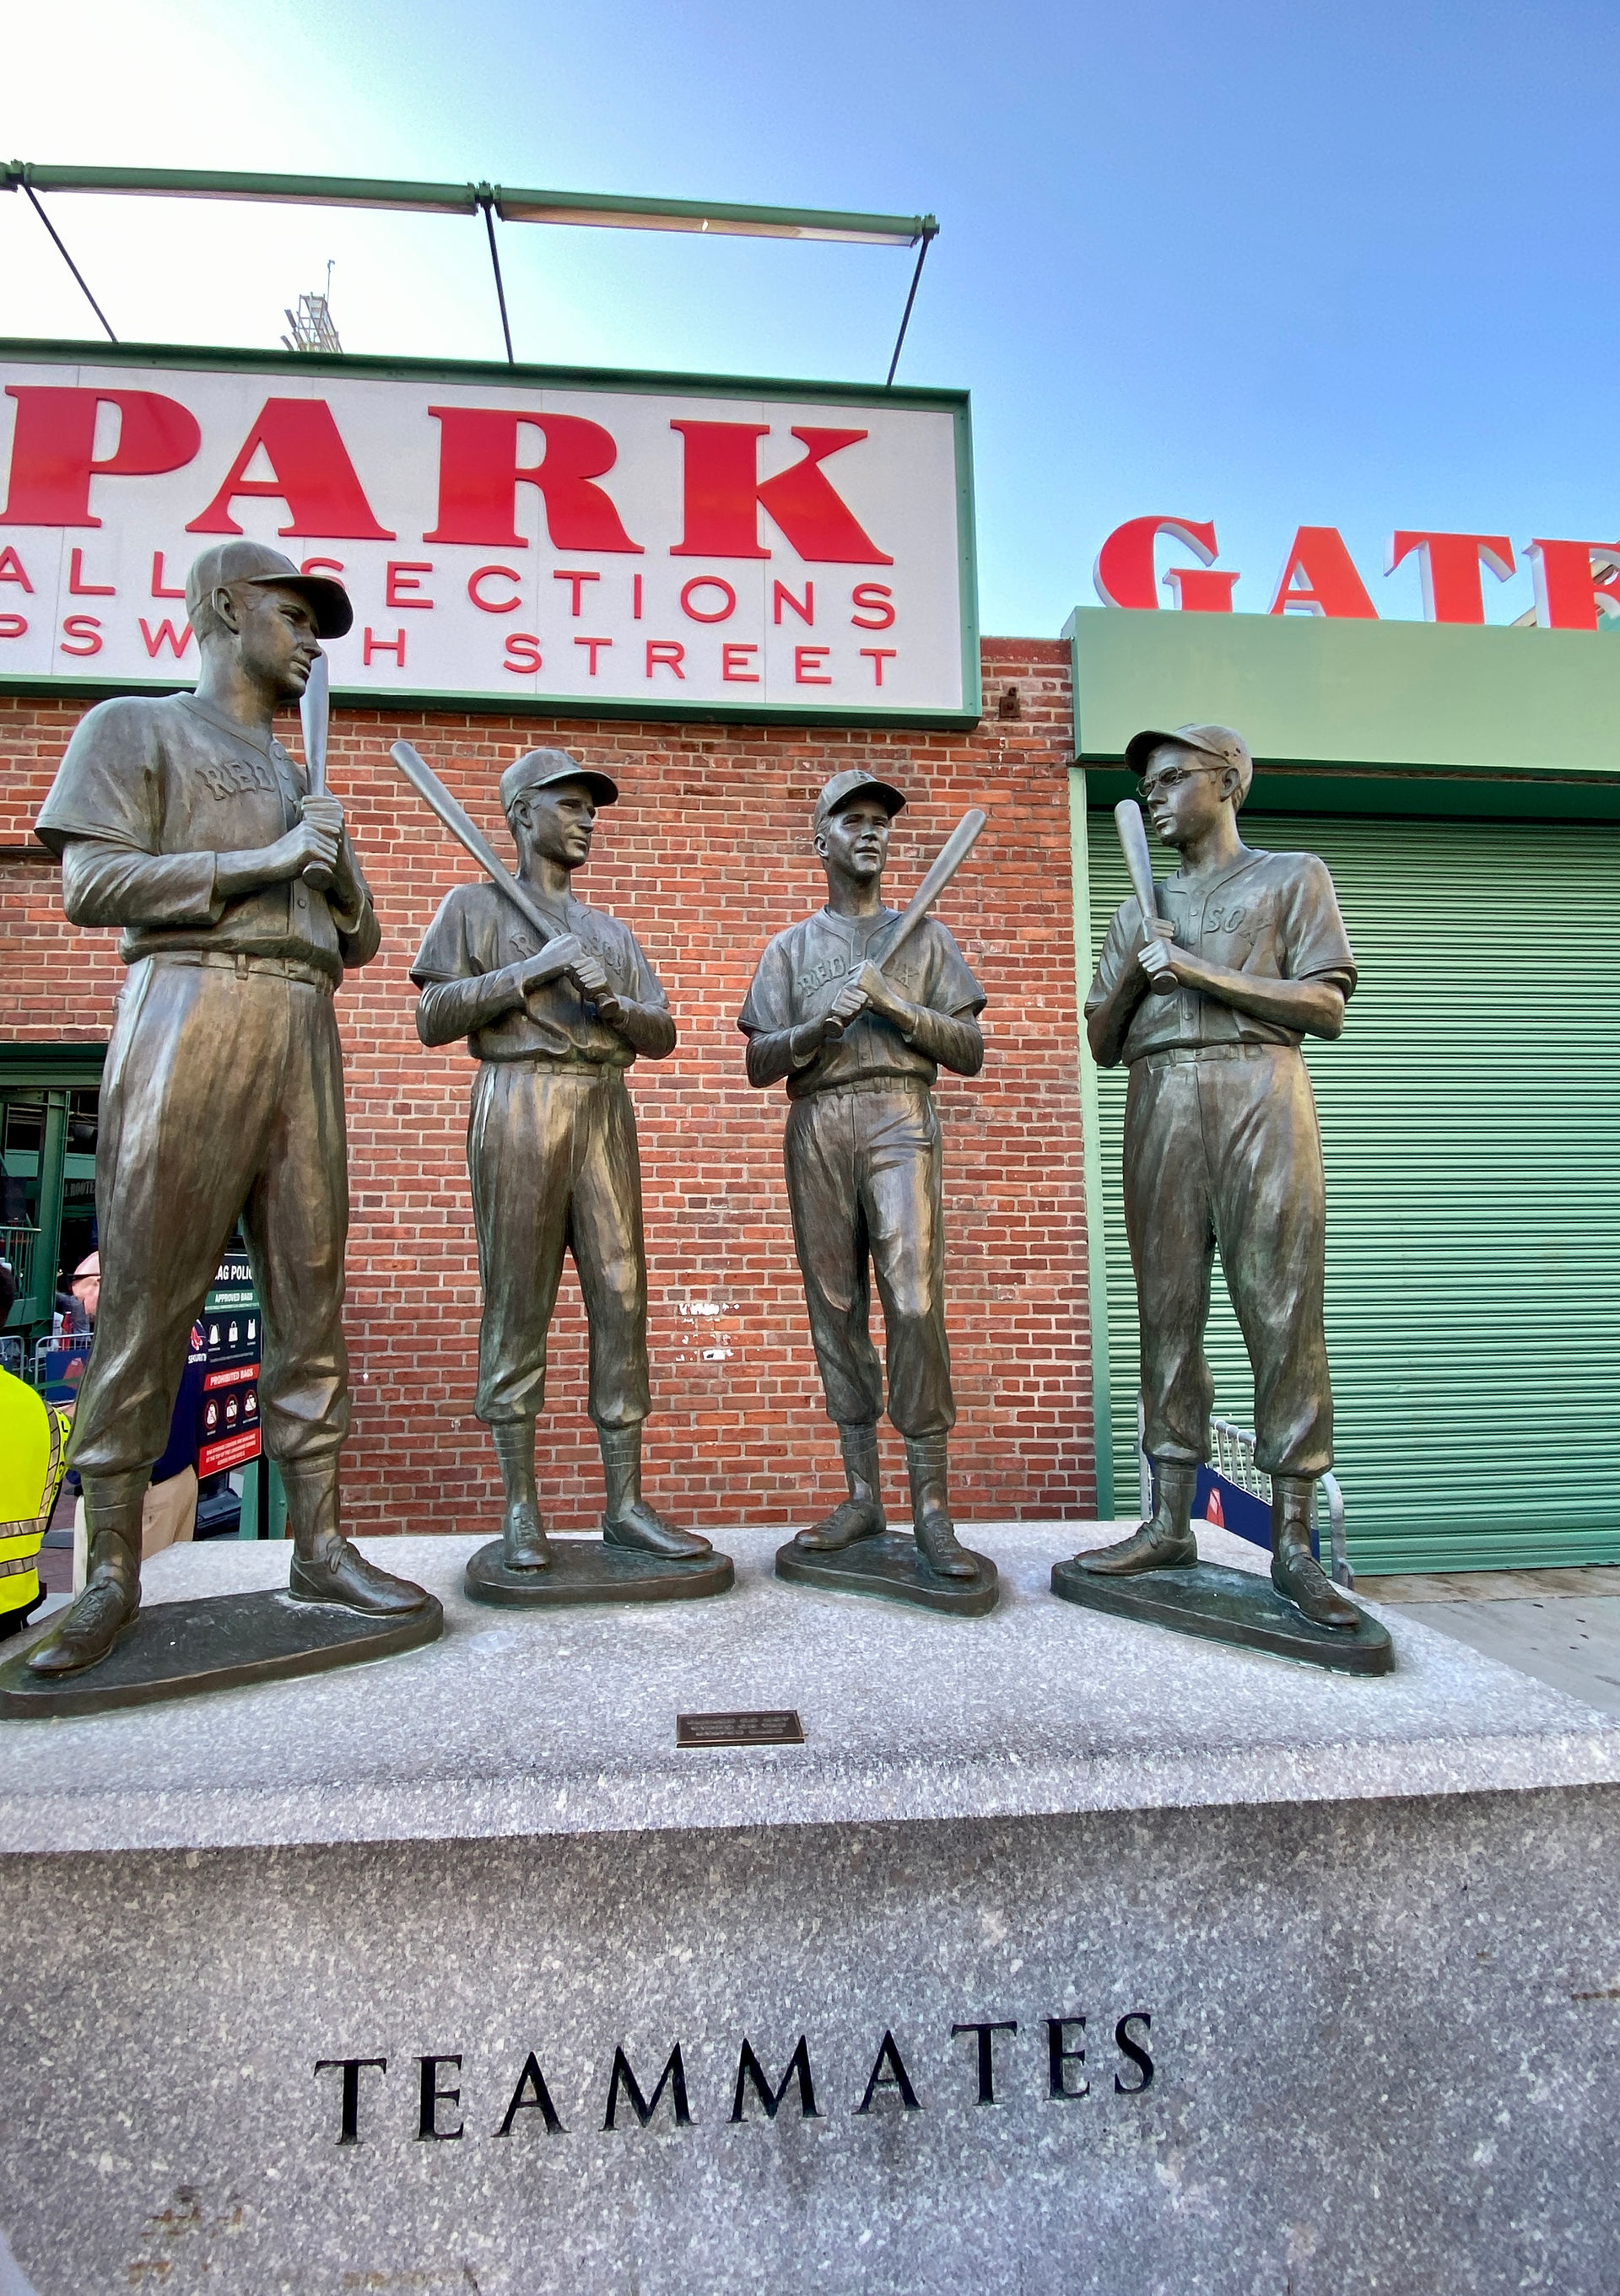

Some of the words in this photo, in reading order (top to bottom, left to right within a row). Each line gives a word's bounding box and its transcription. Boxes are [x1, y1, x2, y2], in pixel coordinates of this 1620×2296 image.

[0, 385, 894, 565] PARK
[504, 633, 896, 686] STREET
[195, 760, 277, 800] RED
[215, 1265, 230, 1280] AG
[314, 2012, 1155, 2146] TEAMMATES
